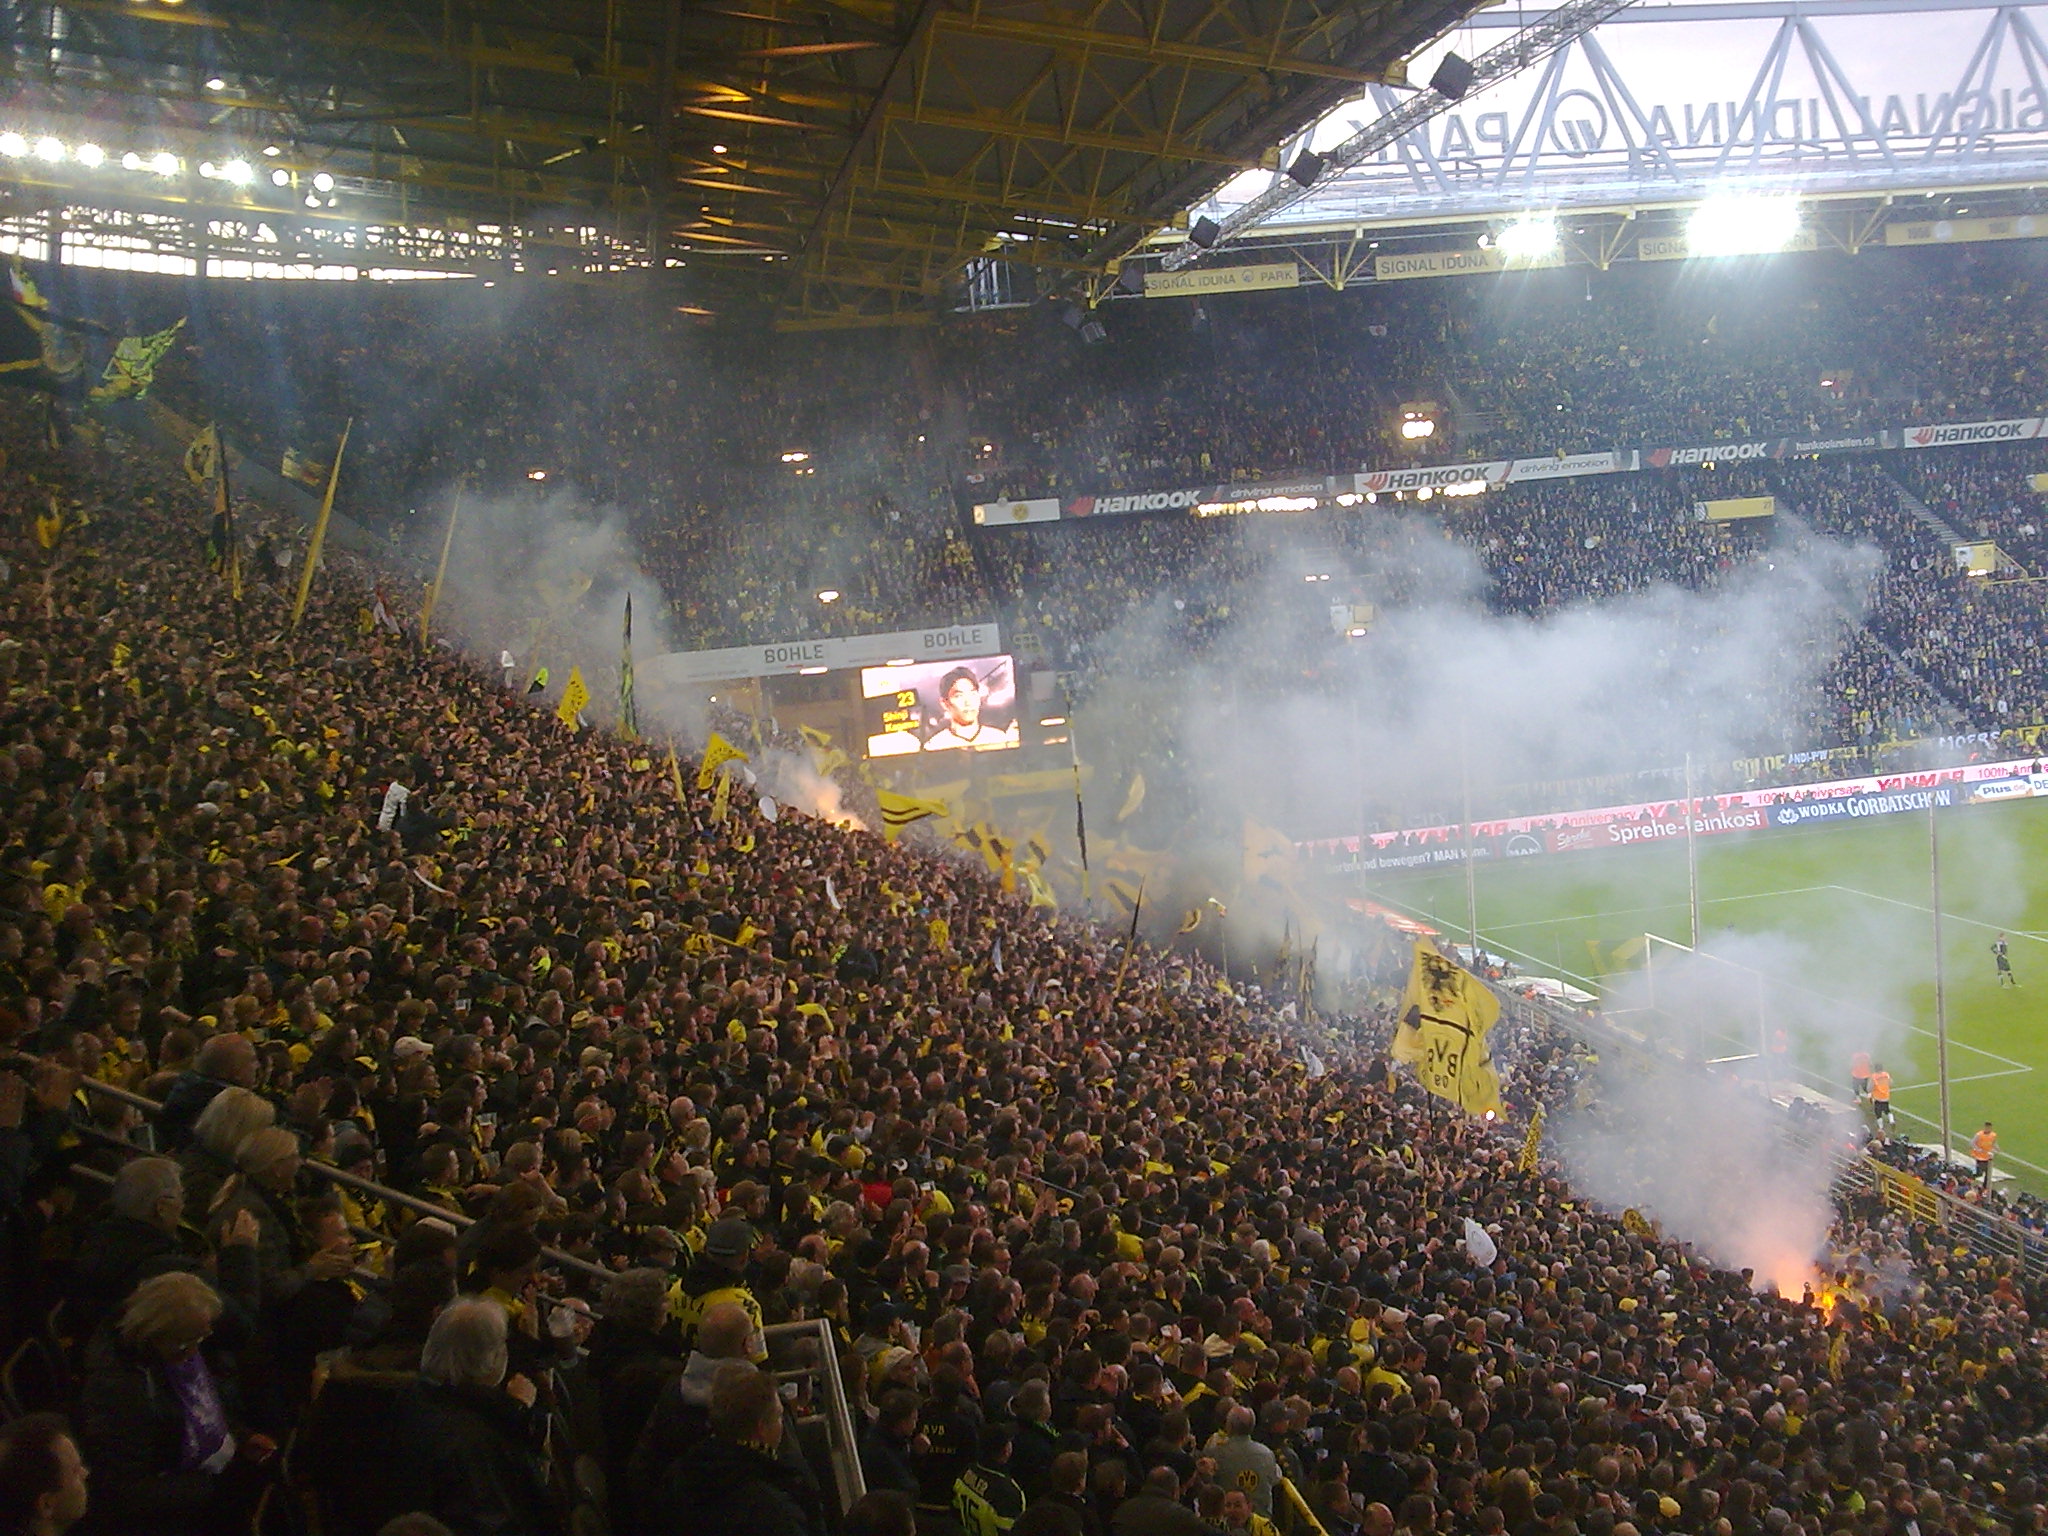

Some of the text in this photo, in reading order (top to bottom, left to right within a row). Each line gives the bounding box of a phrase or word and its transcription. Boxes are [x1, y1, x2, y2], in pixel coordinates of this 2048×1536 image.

[1380, 258, 1437, 274] SIGNAL
[1441, 255, 1489, 270] IDUNA
[1150, 270, 1294, 290] SIGNAL IDUNA PARK
[1520, 463, 1560, 475] driving
[1562, 459, 1609, 471] emotion
[1230, 486, 1272, 499] driving
[1273, 483, 1323, 494] emotion
[924, 628, 983, 650] BOHLE
[764, 644, 825, 665] BOHLE
[897, 691, 915, 708] 23
[1798, 801, 1846, 819] WODKA
[1378, 850, 1432, 869] bewegen?
[1433, 848, 1459, 863] MAN
